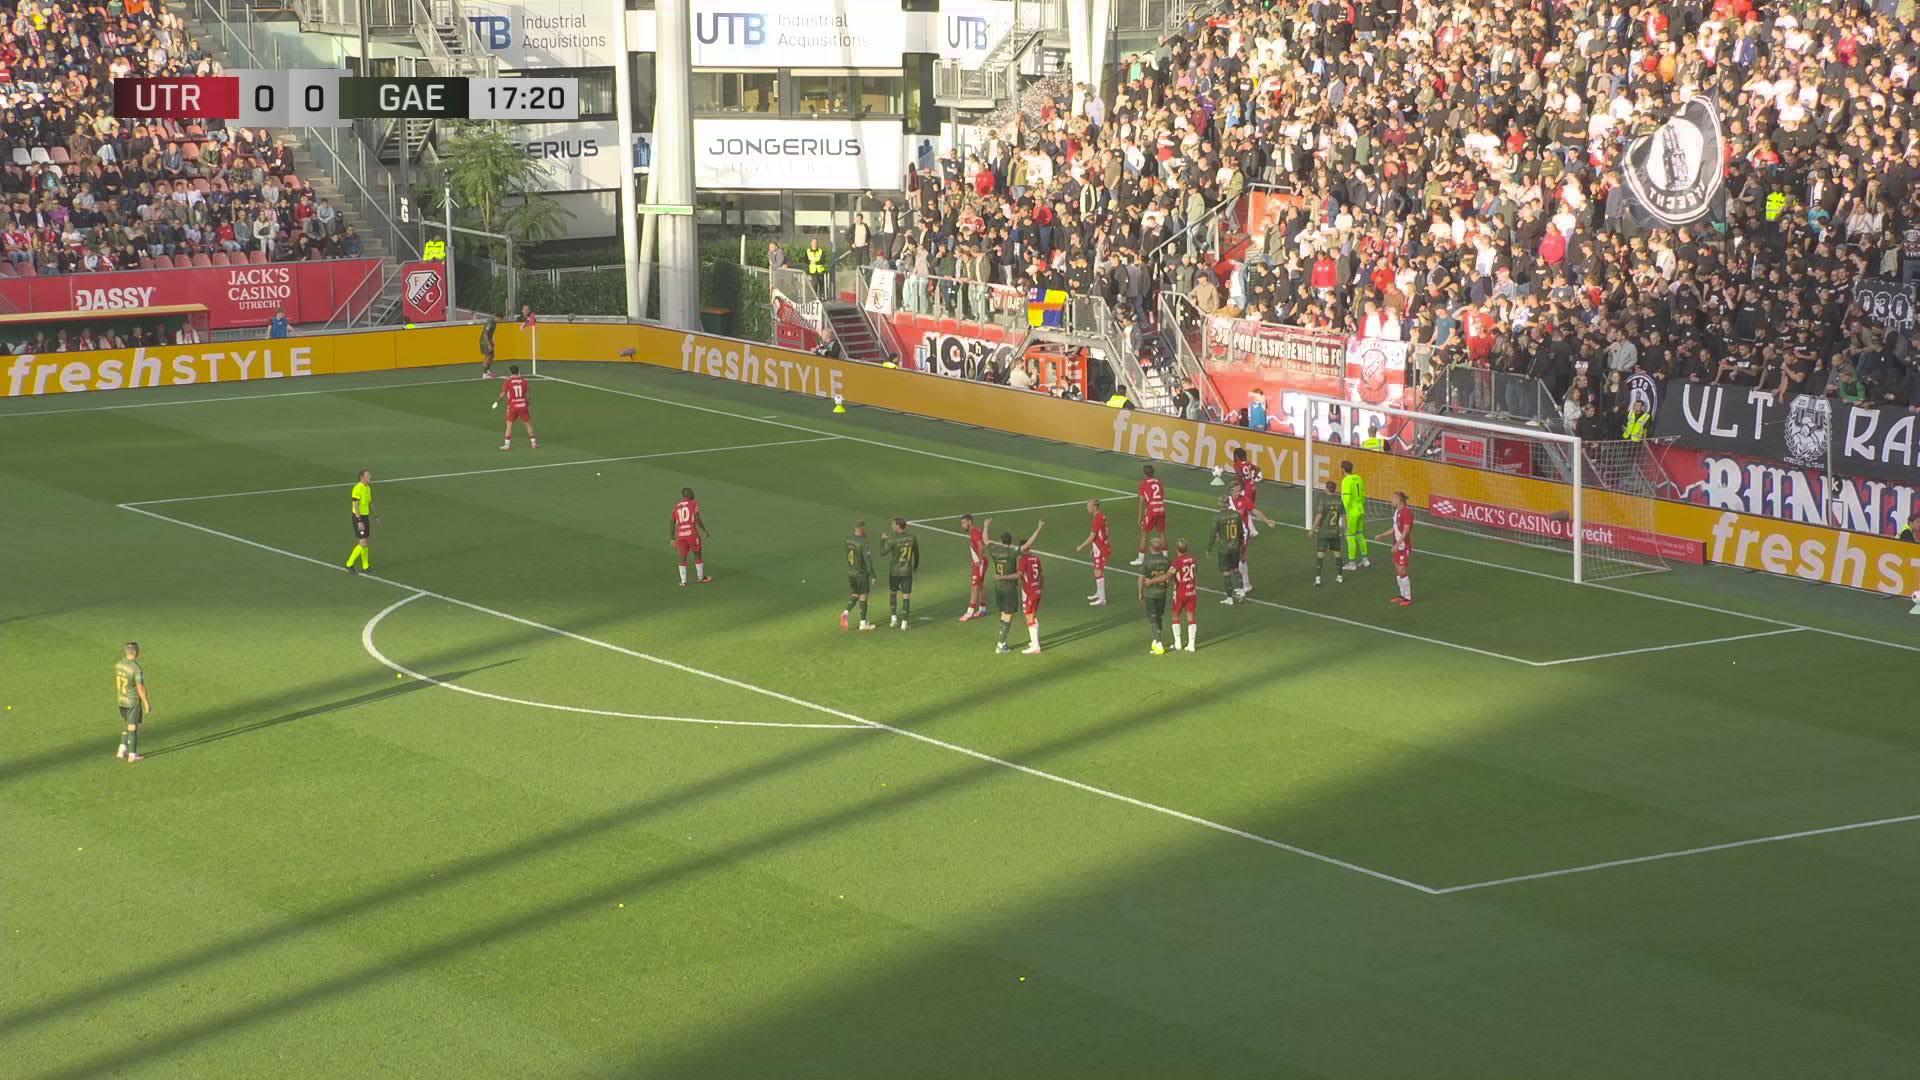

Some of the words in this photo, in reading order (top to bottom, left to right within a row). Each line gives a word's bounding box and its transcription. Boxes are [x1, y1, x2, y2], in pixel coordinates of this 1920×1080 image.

[522, 13, 587, 30] Industrial
[696, 12, 766, 45] UTB
[778, 12, 848, 28] Industrial
[467, 16, 512, 50] TB
[778, 32, 871, 50] Acquisitions
[947, 15, 989, 50] UTB
[521, 34, 606, 51] Acquisitions
[513, 139, 599, 159] ERIUS
[709, 138, 861, 156] JONGERIUS
[228, 267, 290, 286] JACK'S
[228, 285, 291, 301] CASINO
[411, 274, 438, 305] UTRECHT
[76, 286, 154, 311] DASSY
[239, 300, 281, 310] UTRECHT
[513, 385, 523, 398] 11
[1844, 406, 1920, 468] RA
[1150, 483, 1161, 499] 2
[676, 506, 690, 522] 10
[1225, 523, 1238, 540] 10
[1460, 503, 1505, 526] JACK'S
[1509, 512, 1562, 536] CASINO
[1566, 522, 1613, 545] Urecht
[847, 550, 854, 566] 4
[899, 545, 913, 562] 21
[1031, 563, 1039, 579] 5
